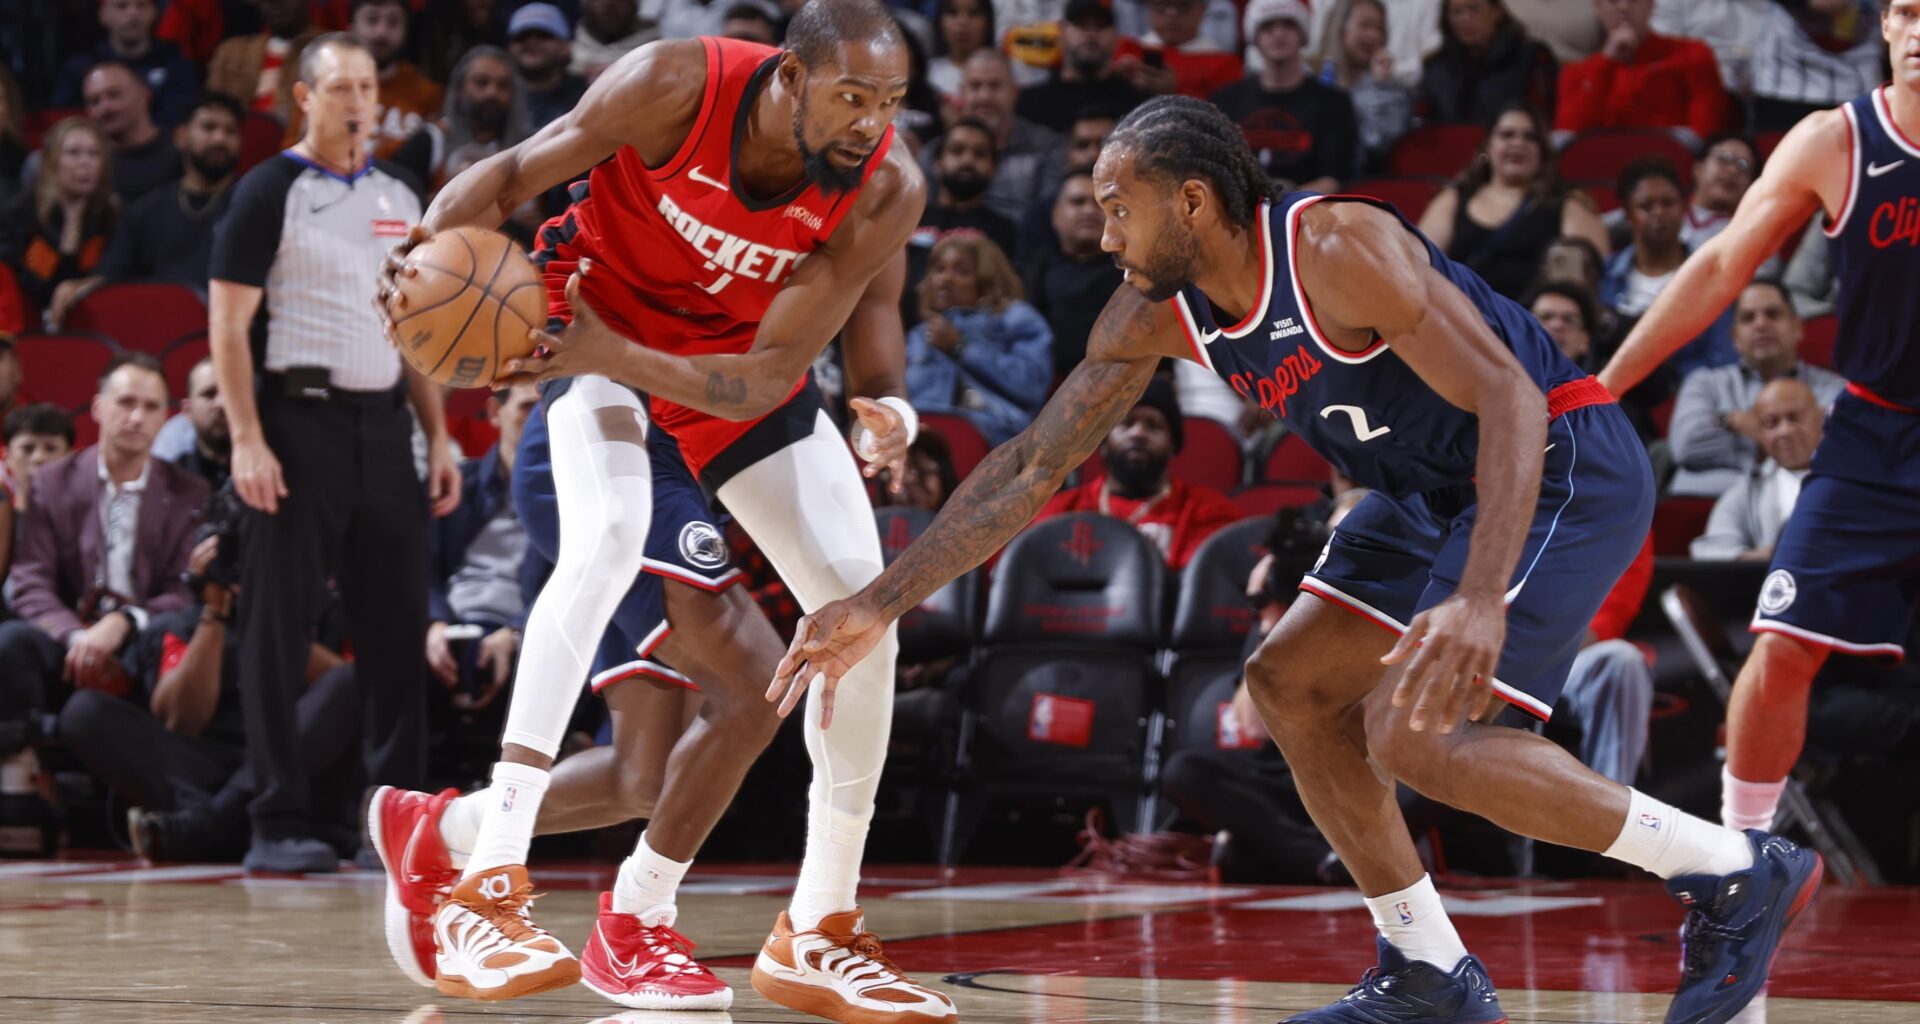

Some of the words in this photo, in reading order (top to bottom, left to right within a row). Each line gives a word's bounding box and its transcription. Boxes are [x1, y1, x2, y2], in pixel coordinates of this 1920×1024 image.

[1273, 317, 1294, 329] VISIT
[1270, 325, 1304, 341] RWANDA
[1319, 404, 1391, 442] 2
